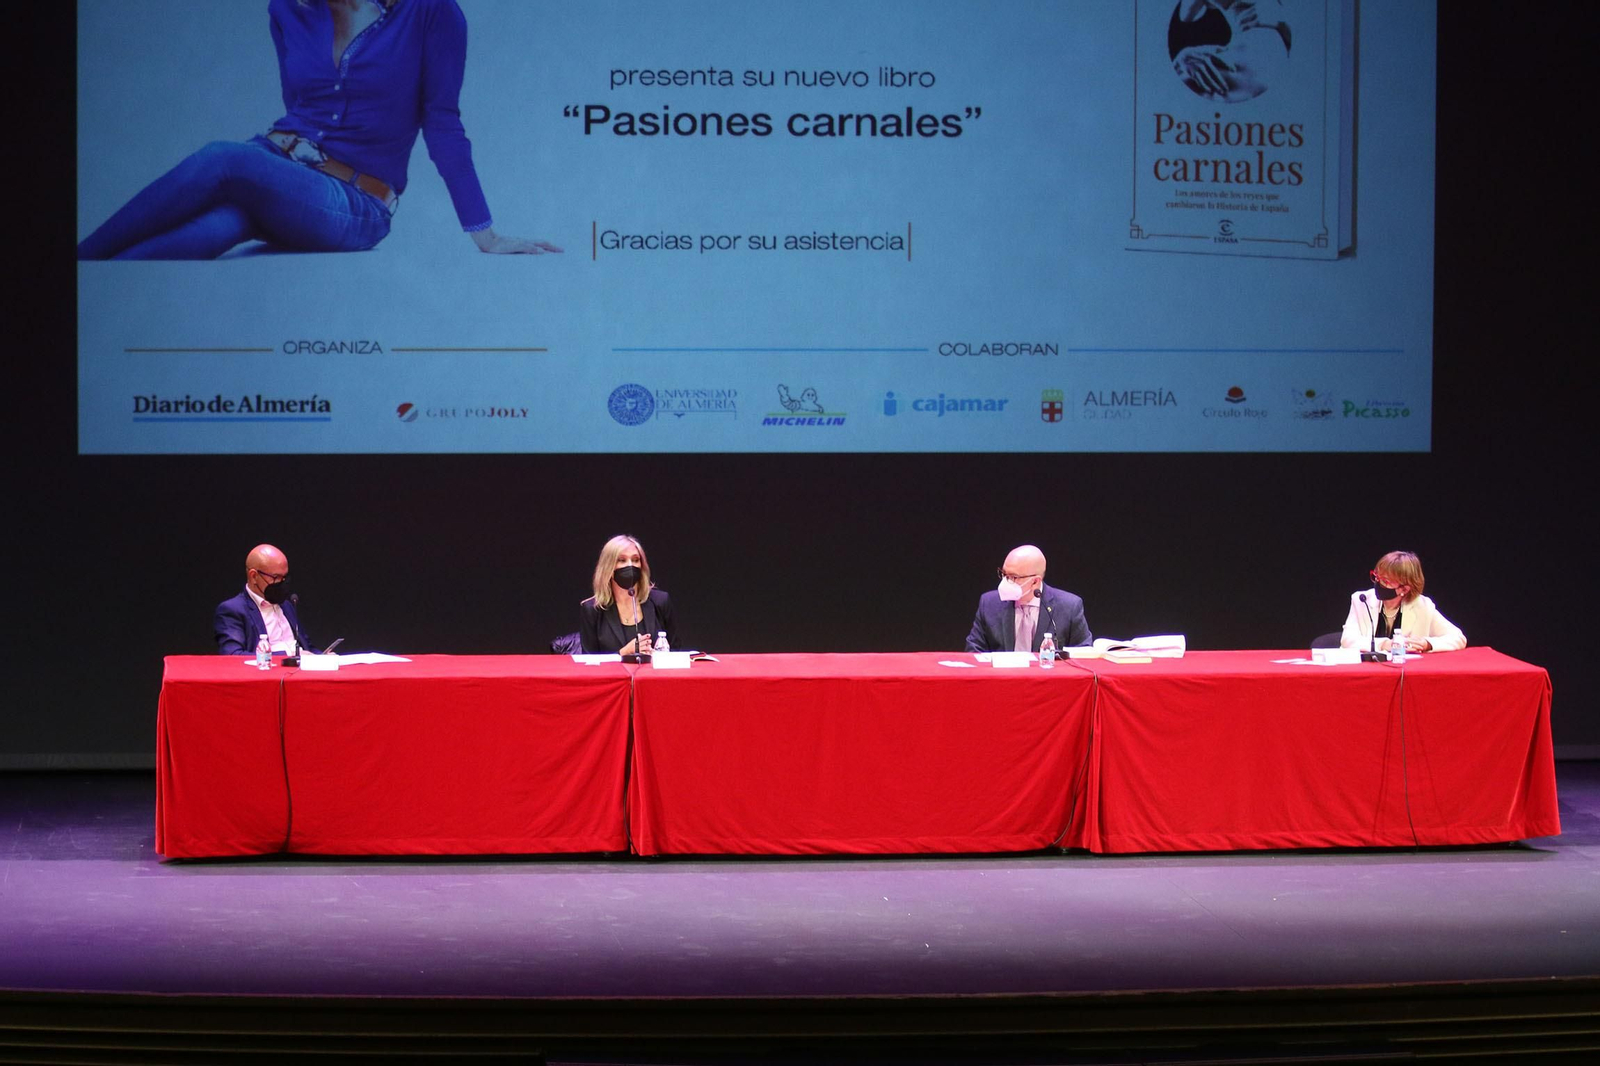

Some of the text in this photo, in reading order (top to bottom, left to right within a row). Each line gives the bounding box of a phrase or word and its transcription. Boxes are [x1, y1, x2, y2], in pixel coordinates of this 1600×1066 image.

[609, 66, 936, 91] presenta su nuevo libro
[1153, 112, 1305, 147] Pasiones
[1153, 150, 1304, 186] carnales
[599, 231, 905, 255] Gracias por su asistencia
[282, 340, 383, 355] ORGANIZA
[938, 342, 1059, 357] COLABORAN
[655, 389, 738, 398] UNIVERSIDAD
[1083, 387, 1178, 406] ALMERÍA
[911, 392, 1010, 417] cajamar
[1342, 400, 1411, 419] Picasso
[761, 416, 846, 427] MICHELIN
